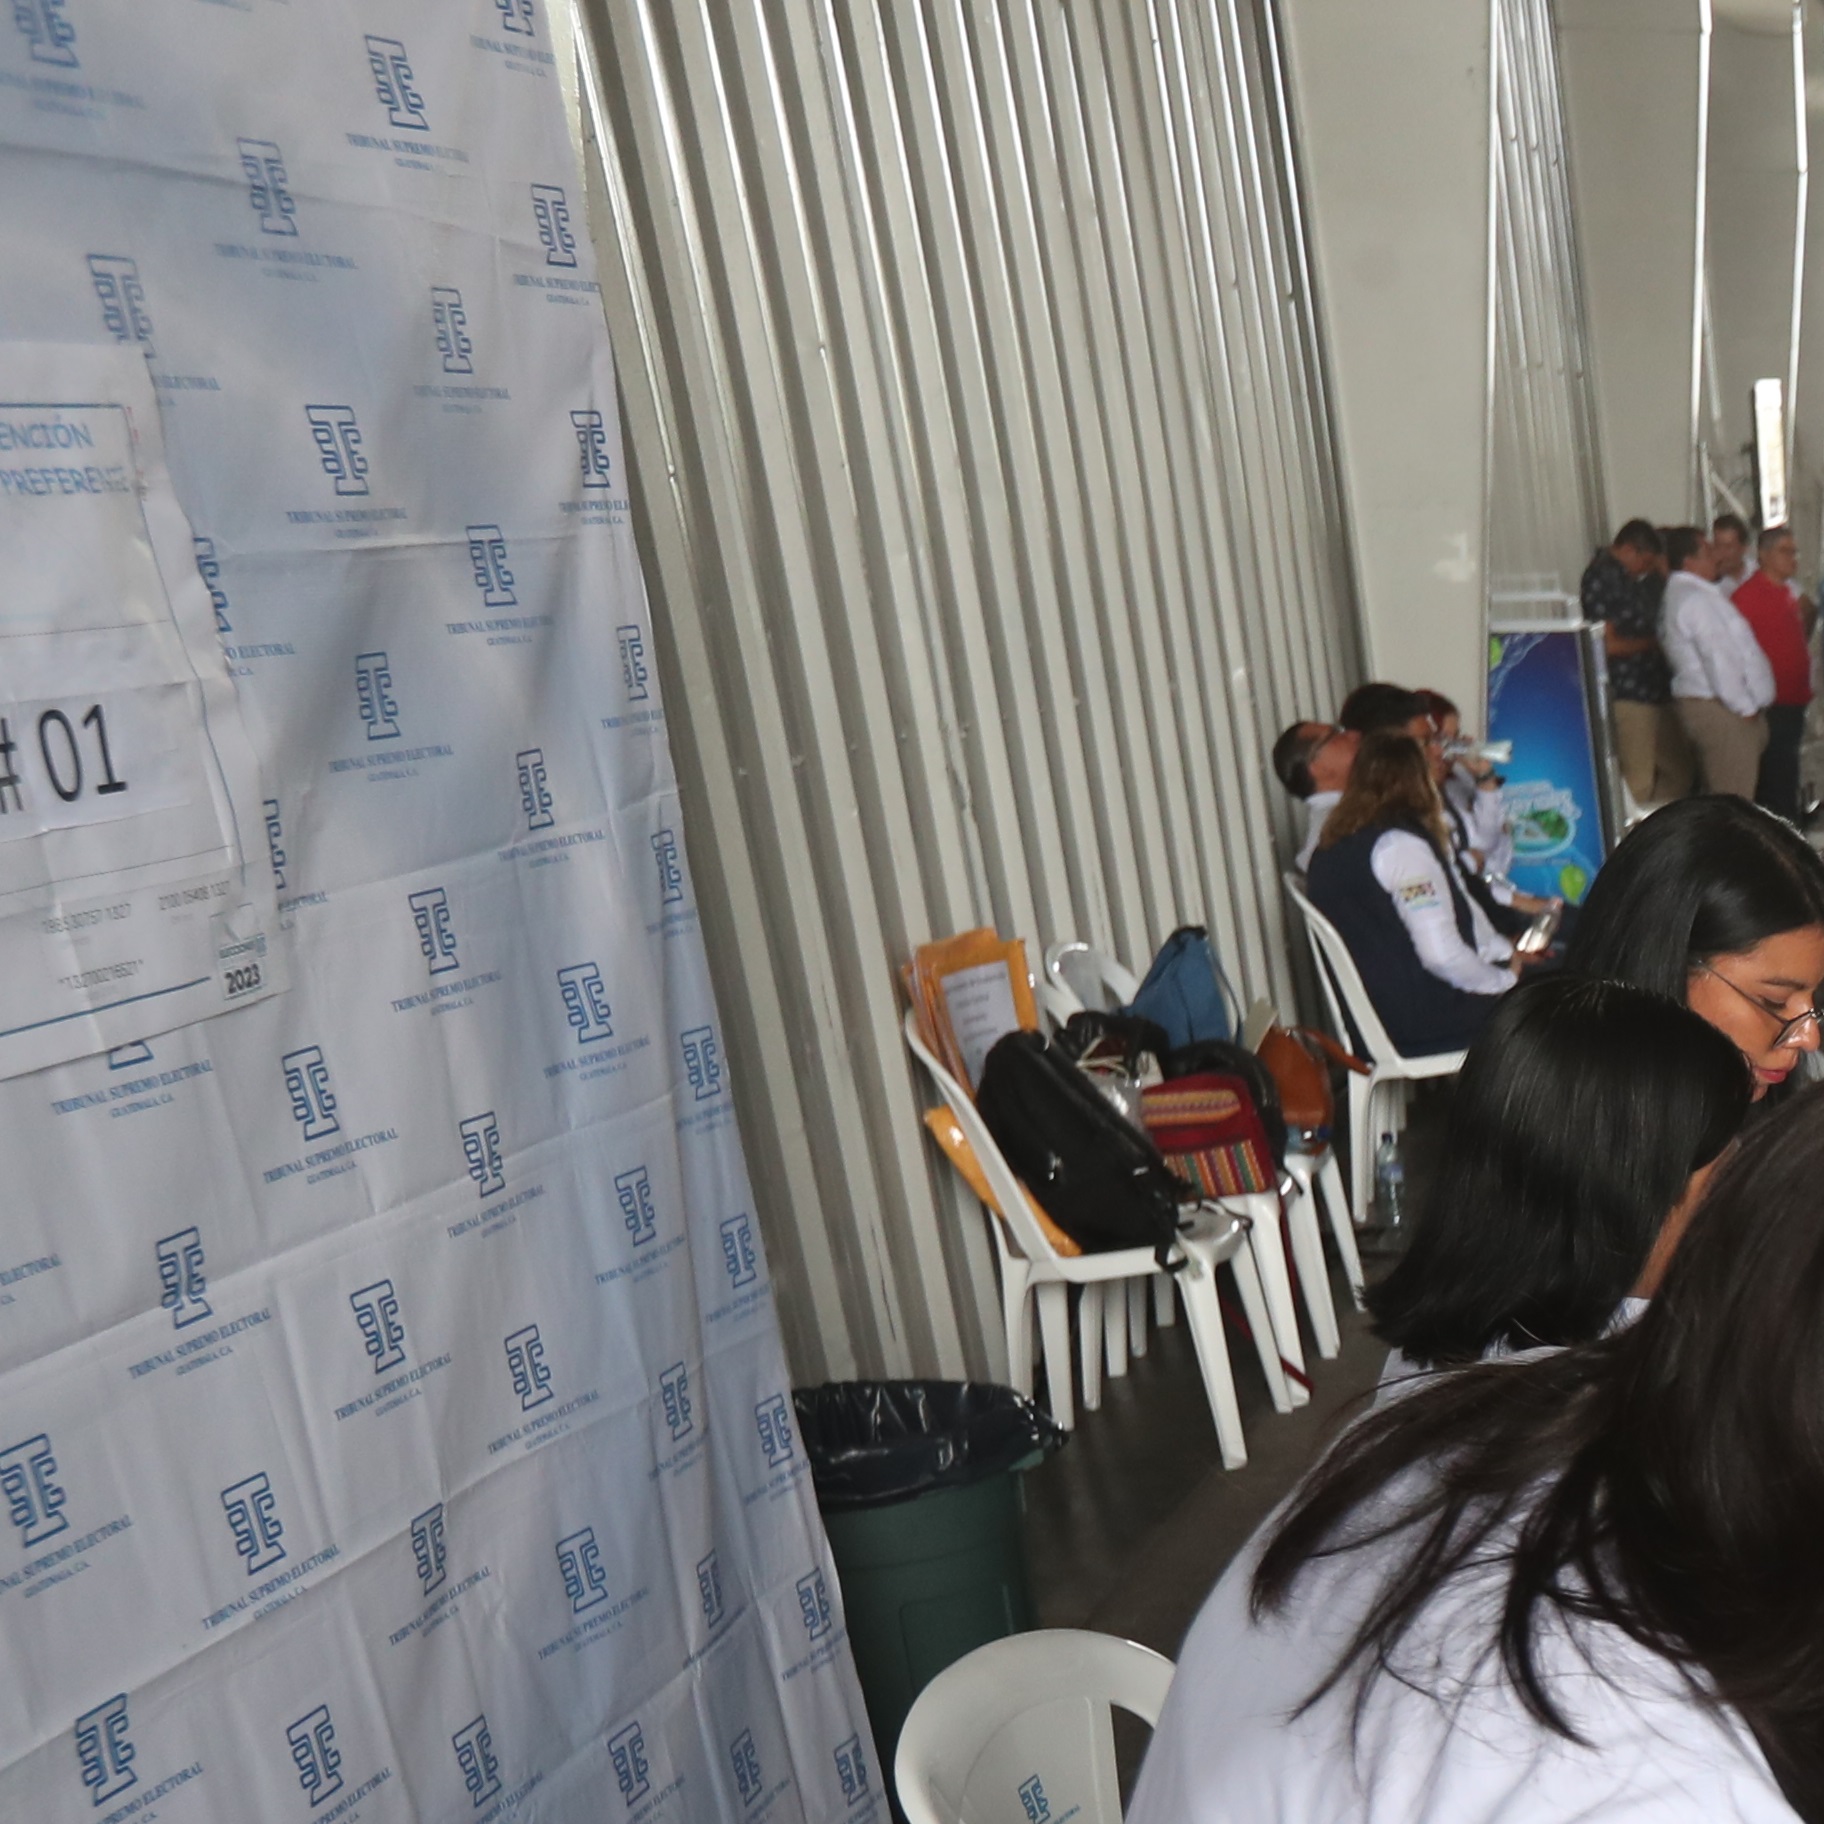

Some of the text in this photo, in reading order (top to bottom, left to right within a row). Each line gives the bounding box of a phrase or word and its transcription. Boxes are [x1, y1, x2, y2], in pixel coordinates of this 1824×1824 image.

[224, 963, 261, 995] 2023
[51, 1060, 213, 1116] TRIBUNAL SUPREMO ELECTORAL
[263, 1127, 399, 1184] TRIBUNAL SUPREMO ELECTORAL
[128, 1308, 272, 1379] TRIBUNAL SUPREMO ELECTORAL
[335, 1352, 453, 1421] TRIBUNAL SUPREMO ELECTORAL
[202, 1543, 341, 1630] TRIBUNAL SUPREMO ELECTORAL
[140, 1761, 204, 1808] ELECTORAL
[348, 1767, 393, 1808] ELECTORAL
